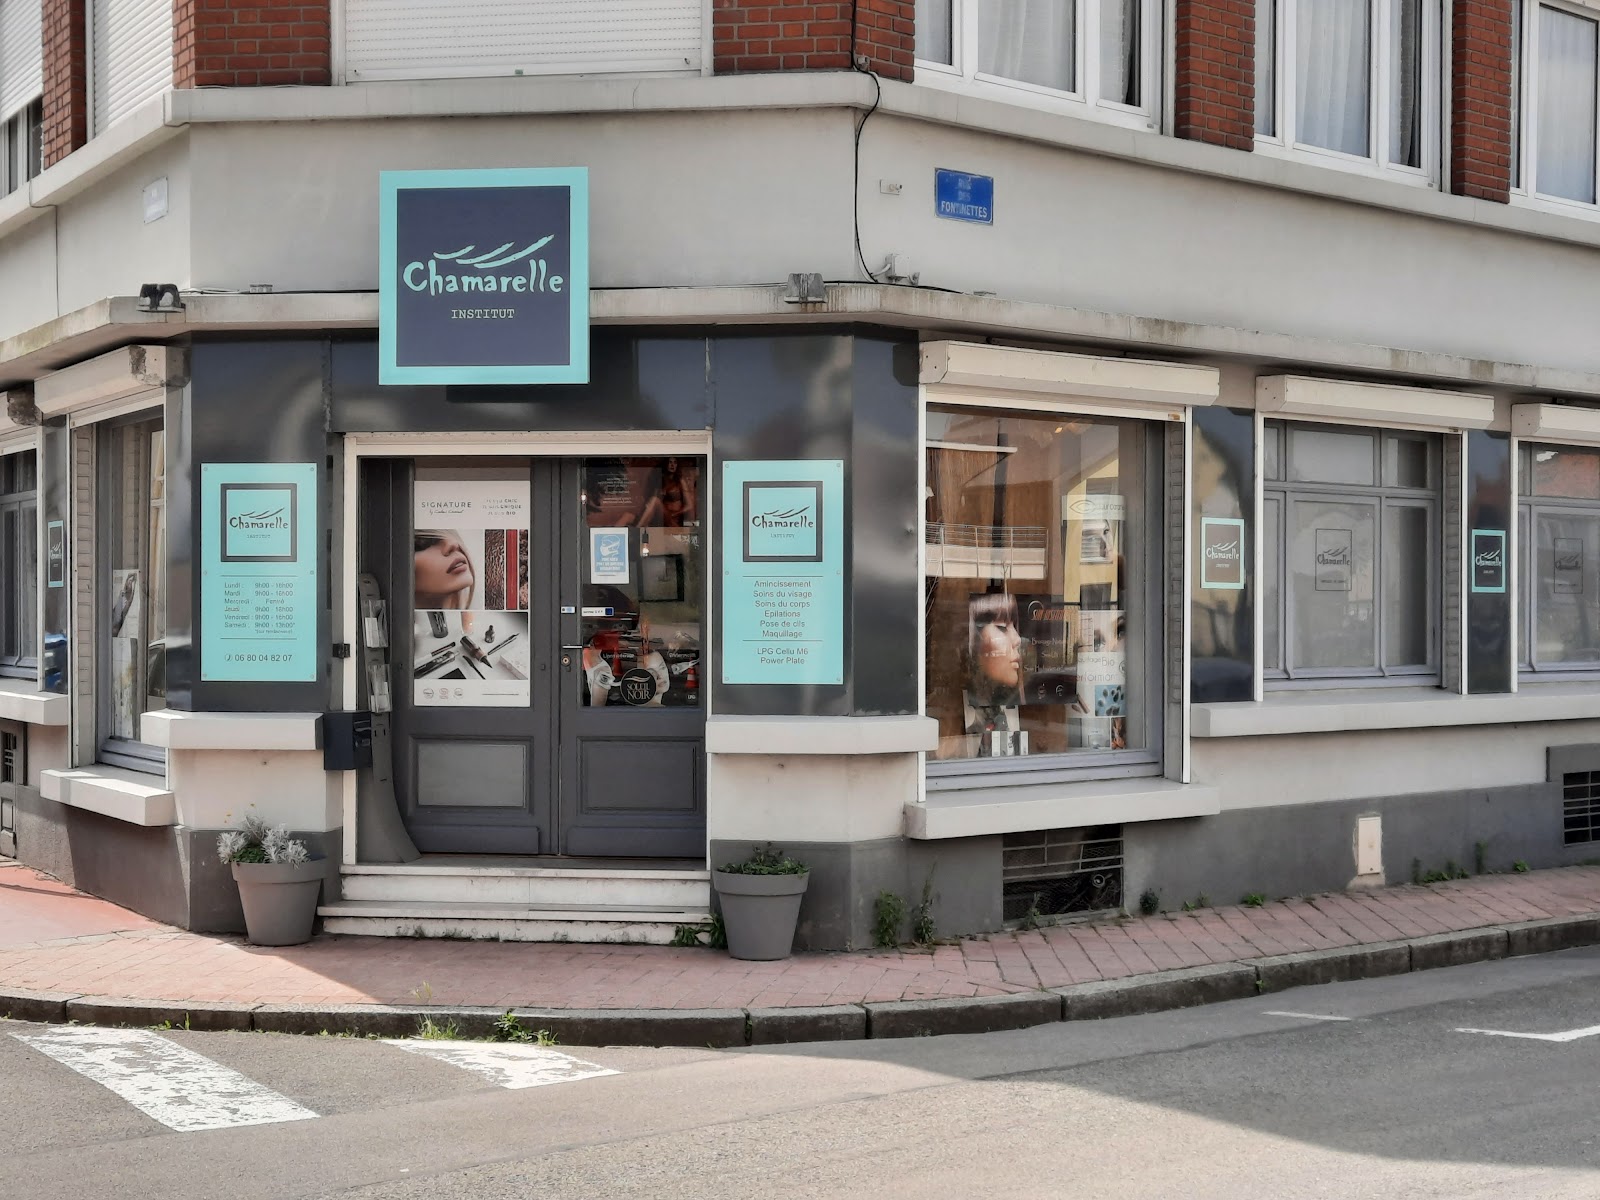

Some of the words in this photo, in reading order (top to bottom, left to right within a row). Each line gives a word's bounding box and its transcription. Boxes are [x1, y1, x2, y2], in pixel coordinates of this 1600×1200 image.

[941, 201, 988, 218] FONTINETTES
[402, 258, 564, 296] Chamarelle
[451, 309, 515, 319] INSTITUT
[229, 516, 289, 529] Chamarelle
[752, 515, 814, 528] Chamarelle
[754, 580, 811, 588] Amincissement
[753, 590, 774, 598] Soins
[787, 591, 812, 599] visage
[764, 610, 801, 619] Epilations
[762, 630, 803, 639] Maquillage
[757, 647, 774, 655] LPG
[775, 647, 795, 655] Cellu
[234, 654, 245, 662] 06
[246, 654, 257, 662] 80
[258, 654, 268, 662] 04
[270, 654, 281, 662] 82
[282, 654, 293, 662] 07
[627, 690, 651, 700] NOIR
